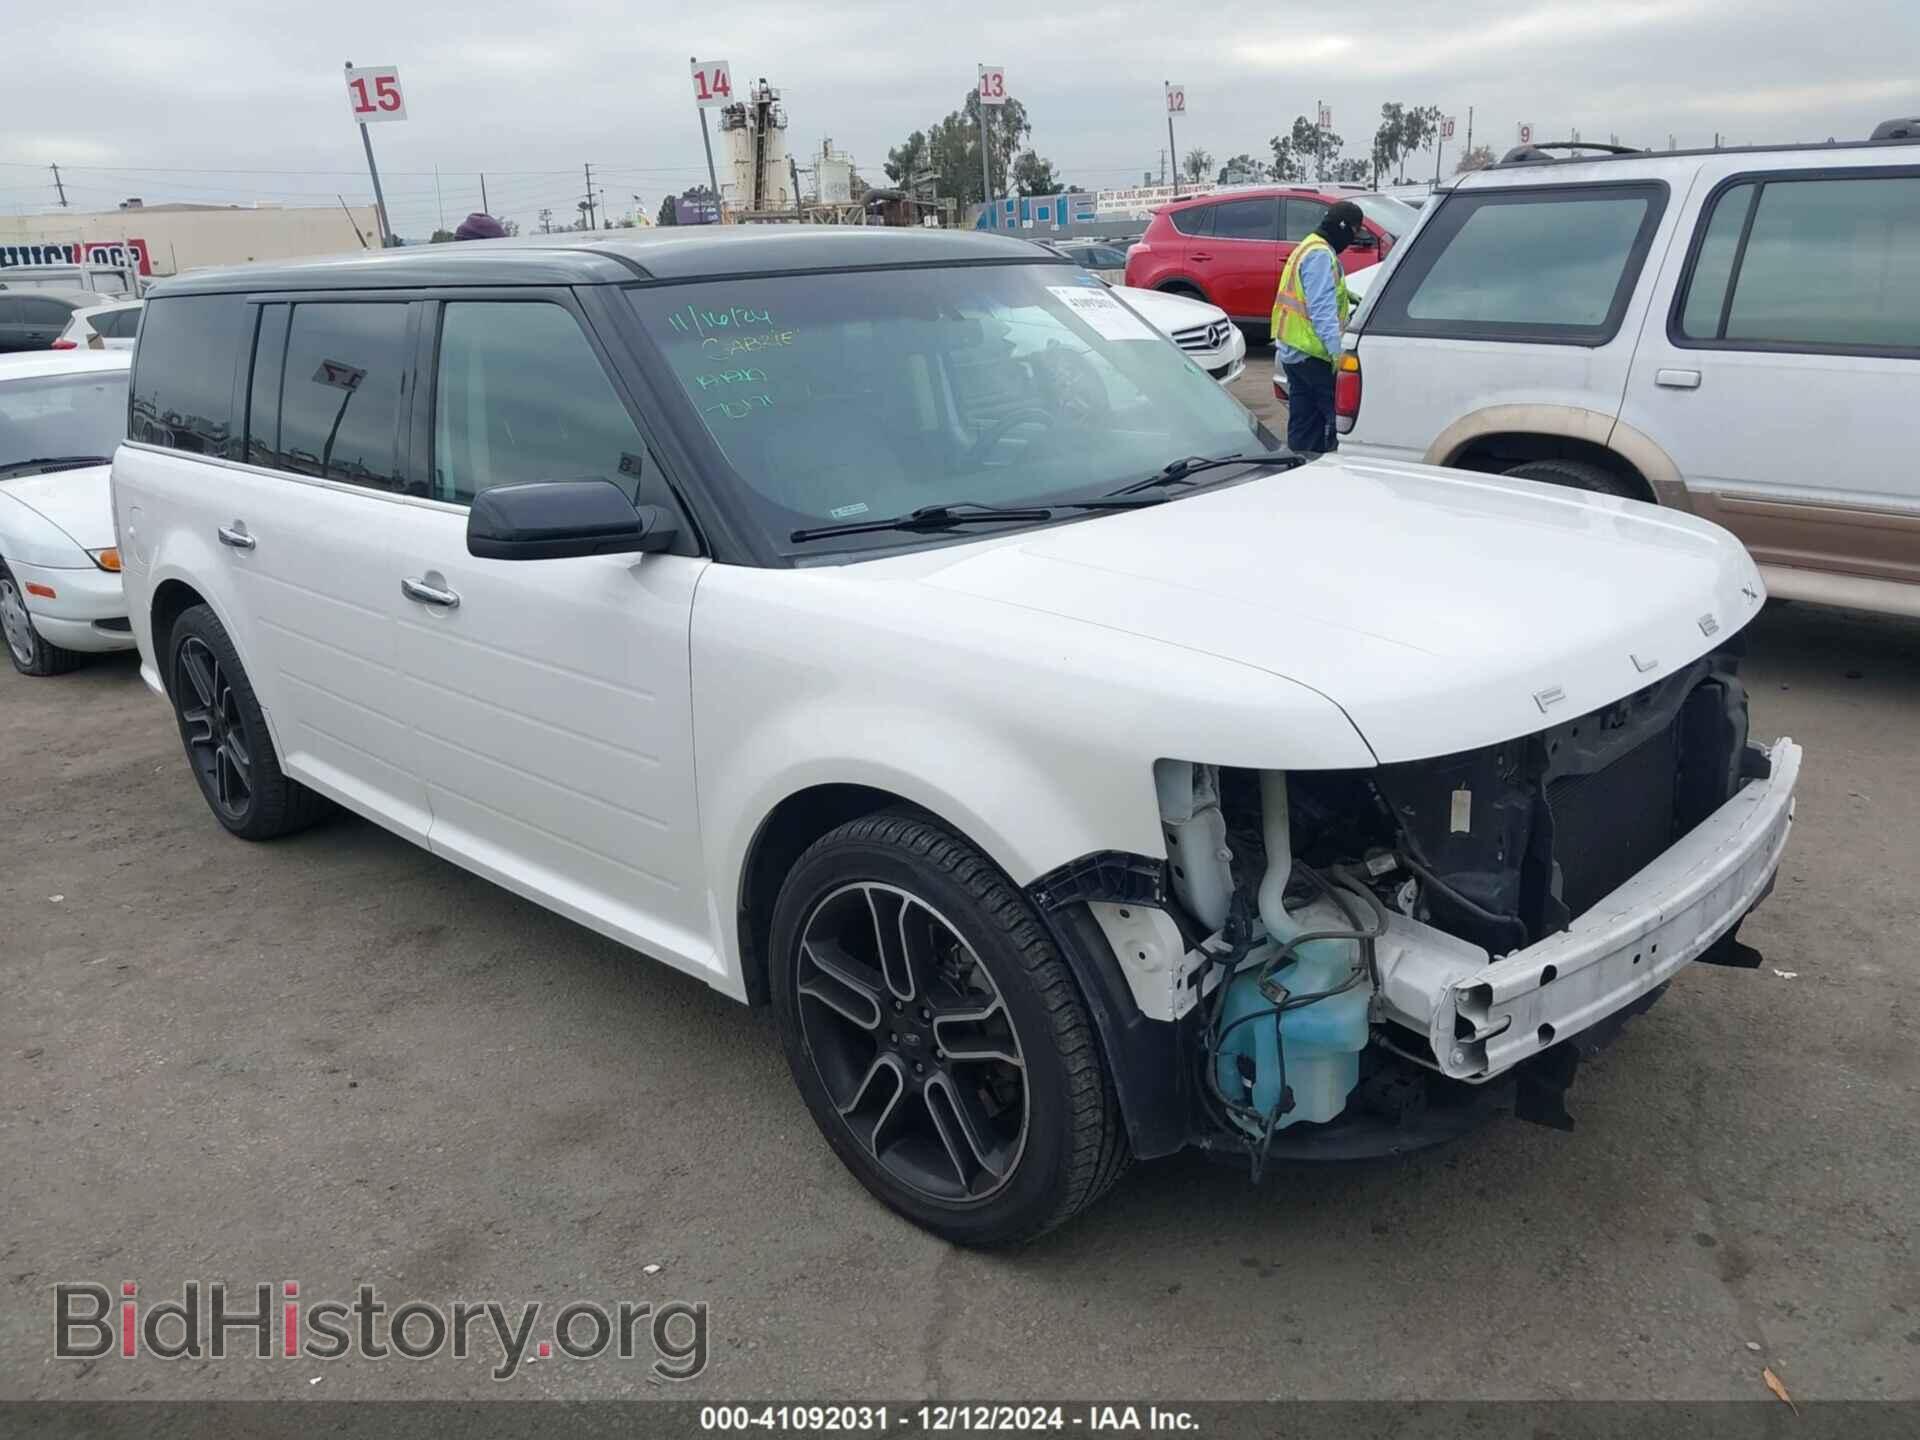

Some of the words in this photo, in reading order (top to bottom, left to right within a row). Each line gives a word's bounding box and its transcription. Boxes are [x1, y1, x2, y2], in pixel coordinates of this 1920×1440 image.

[349, 76, 402, 113] 15
[693, 69, 731, 100] 14
[980, 72, 1005, 98] 13
[1167, 91, 1185, 113] 12
[1319, 110, 1332, 129] 11
[1441, 121, 1454, 137] 10
[1520, 126, 1530, 143] 9
